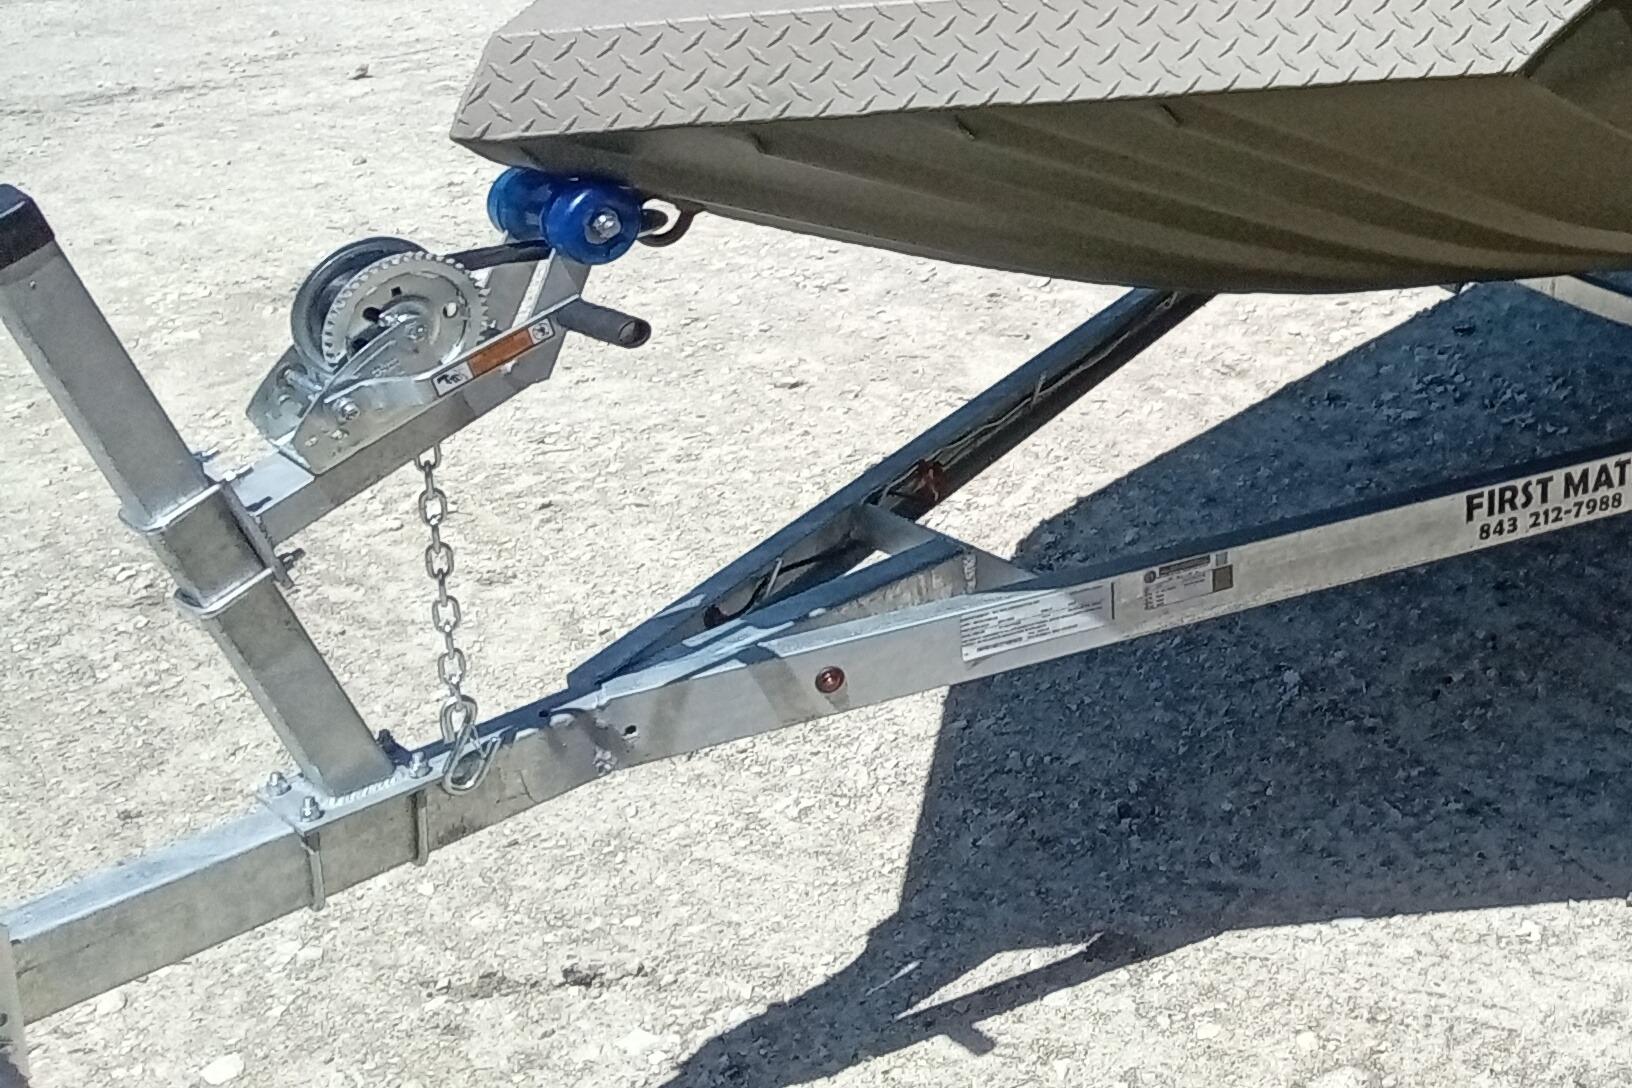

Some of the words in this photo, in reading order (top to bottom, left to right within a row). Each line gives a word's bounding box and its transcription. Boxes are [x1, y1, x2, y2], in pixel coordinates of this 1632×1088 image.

[1465, 475, 1554, 524] FIRST
[1479, 516, 1518, 541] 843
[1528, 492, 1623, 529] 212-7988
